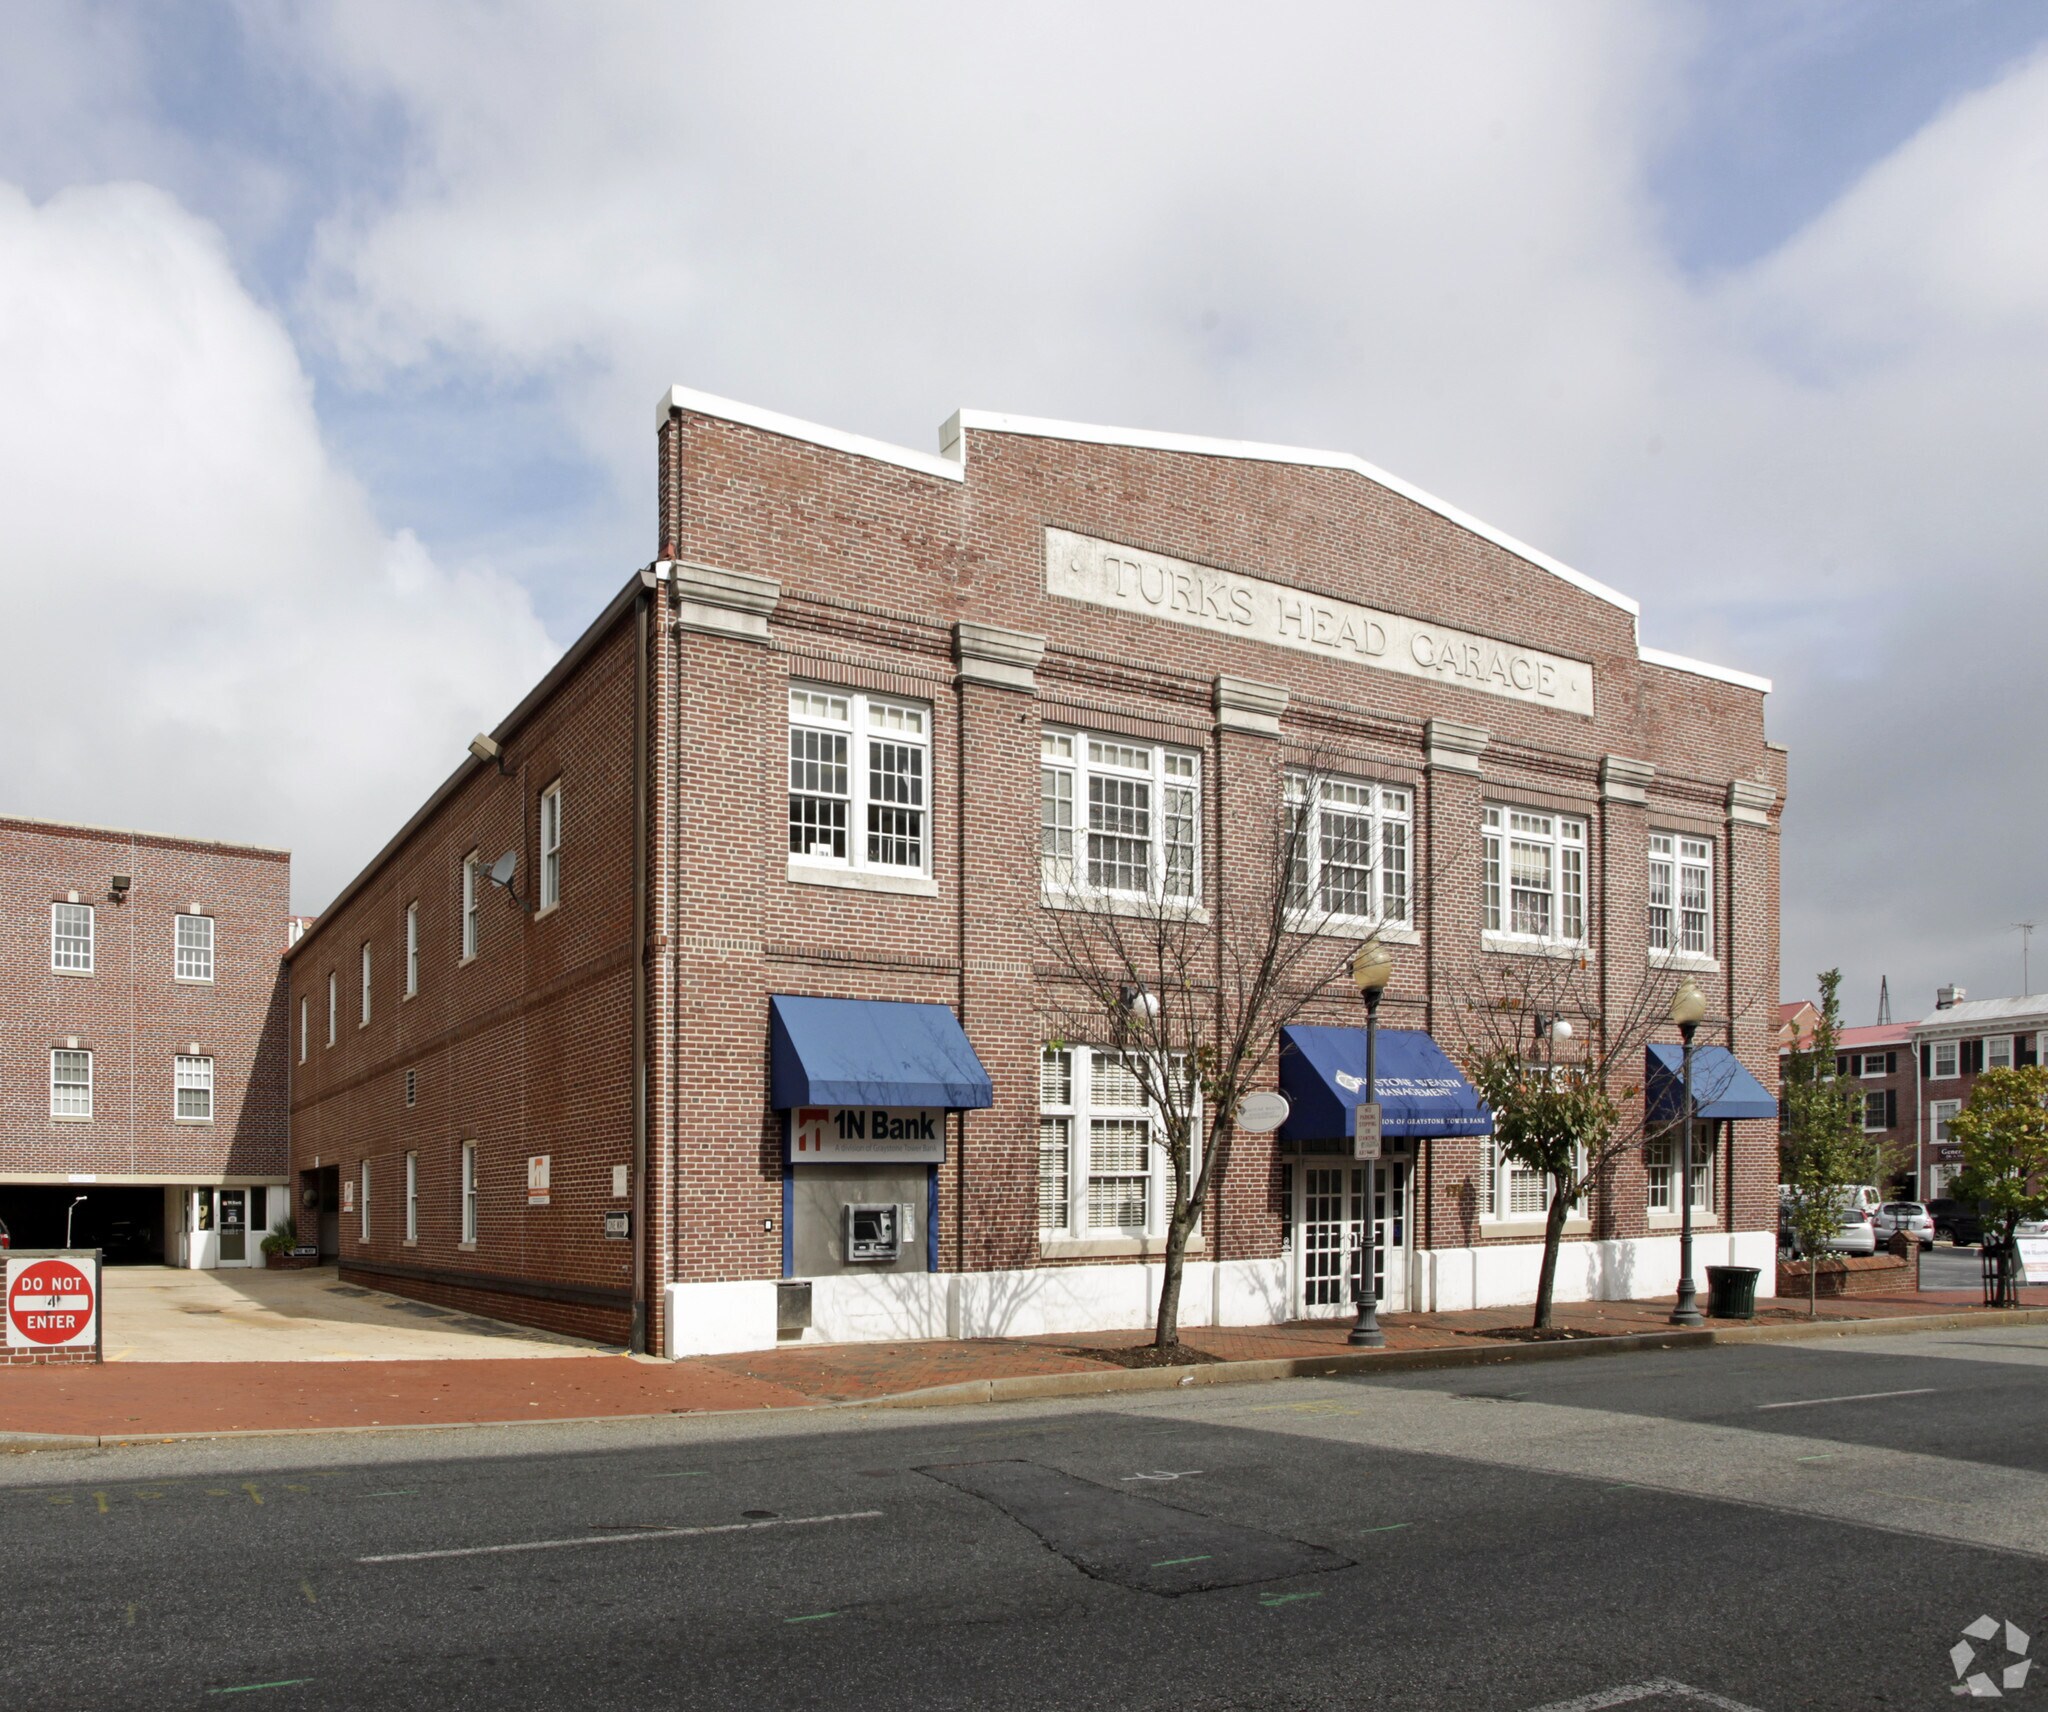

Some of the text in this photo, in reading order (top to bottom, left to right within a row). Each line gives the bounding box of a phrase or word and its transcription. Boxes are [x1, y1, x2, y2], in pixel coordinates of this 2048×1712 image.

[1103, 555, 1557, 698] TURKS HEAD GARAGE
[1415, 1078, 1462, 1088] WEALTH
[1375, 1088, 1453, 1097] MANAGEMENT
[834, 1109, 936, 1140] 1N Bank
[608, 1219, 625, 1231] ONE WAY
[21, 1276, 82, 1291] DO NOT
[26, 1315, 76, 1329] ENTER
